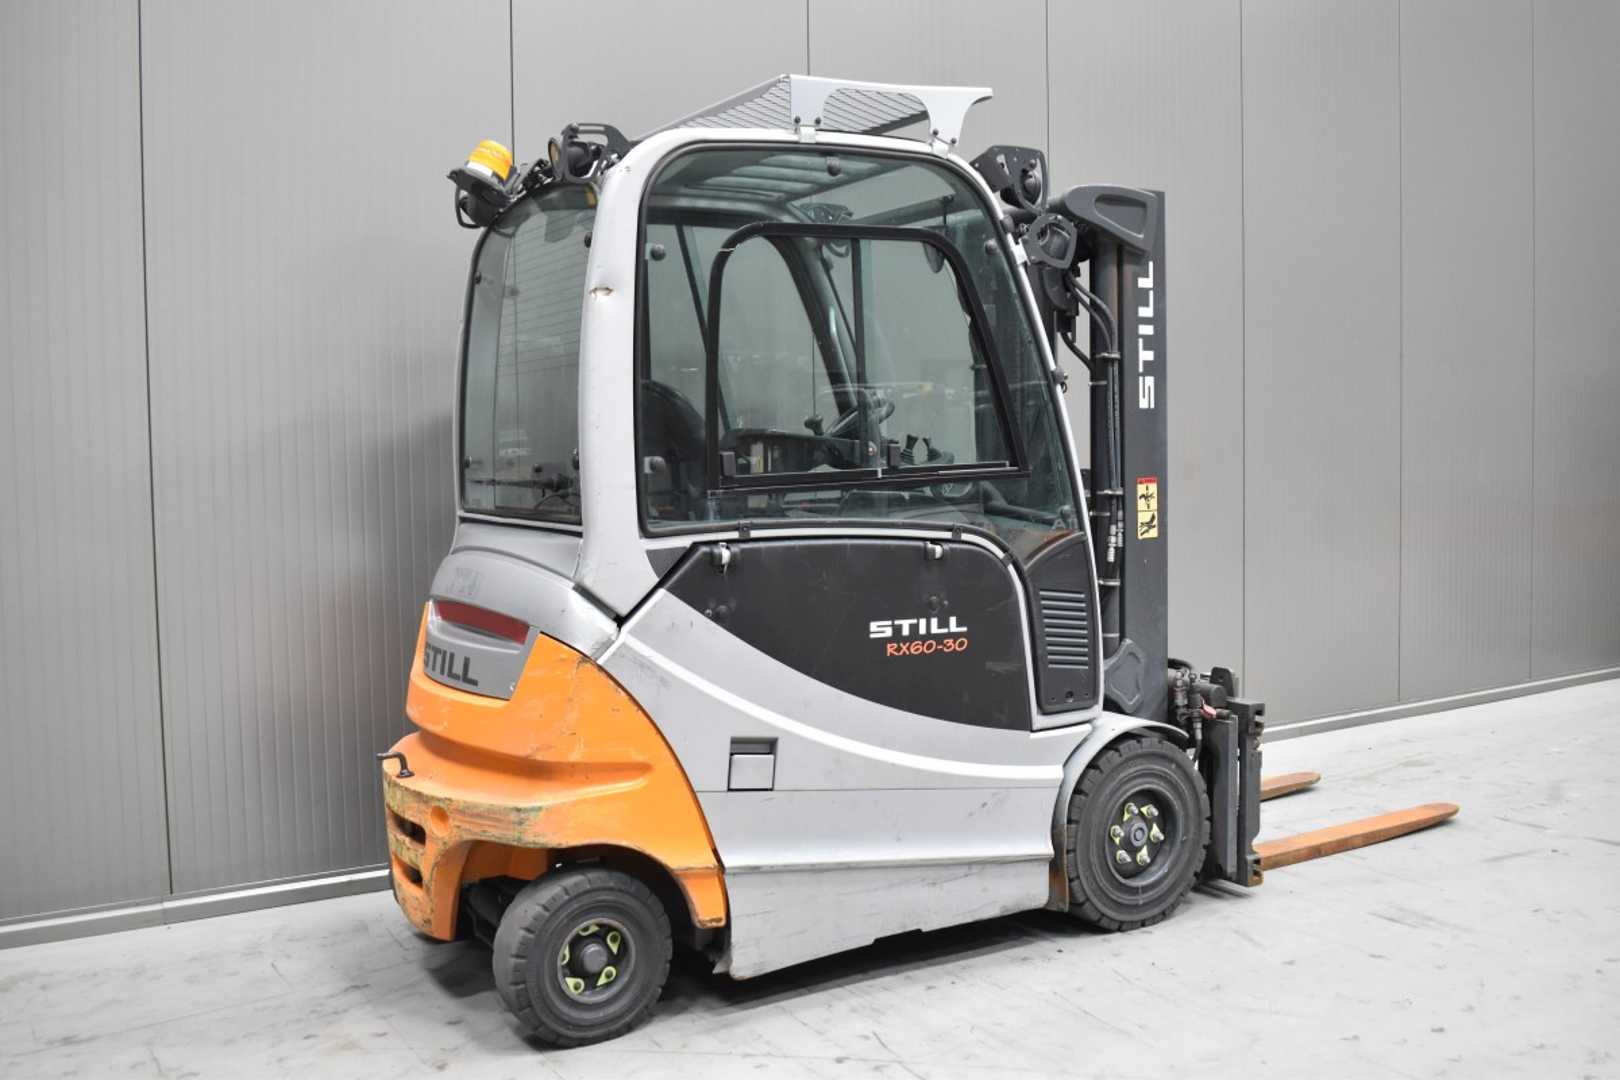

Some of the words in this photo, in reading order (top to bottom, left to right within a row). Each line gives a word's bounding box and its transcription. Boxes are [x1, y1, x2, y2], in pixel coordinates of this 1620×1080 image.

[1138, 261, 1154, 408] STILL
[869, 616, 968, 638] STILL
[886, 638, 968, 656] RX60-30
